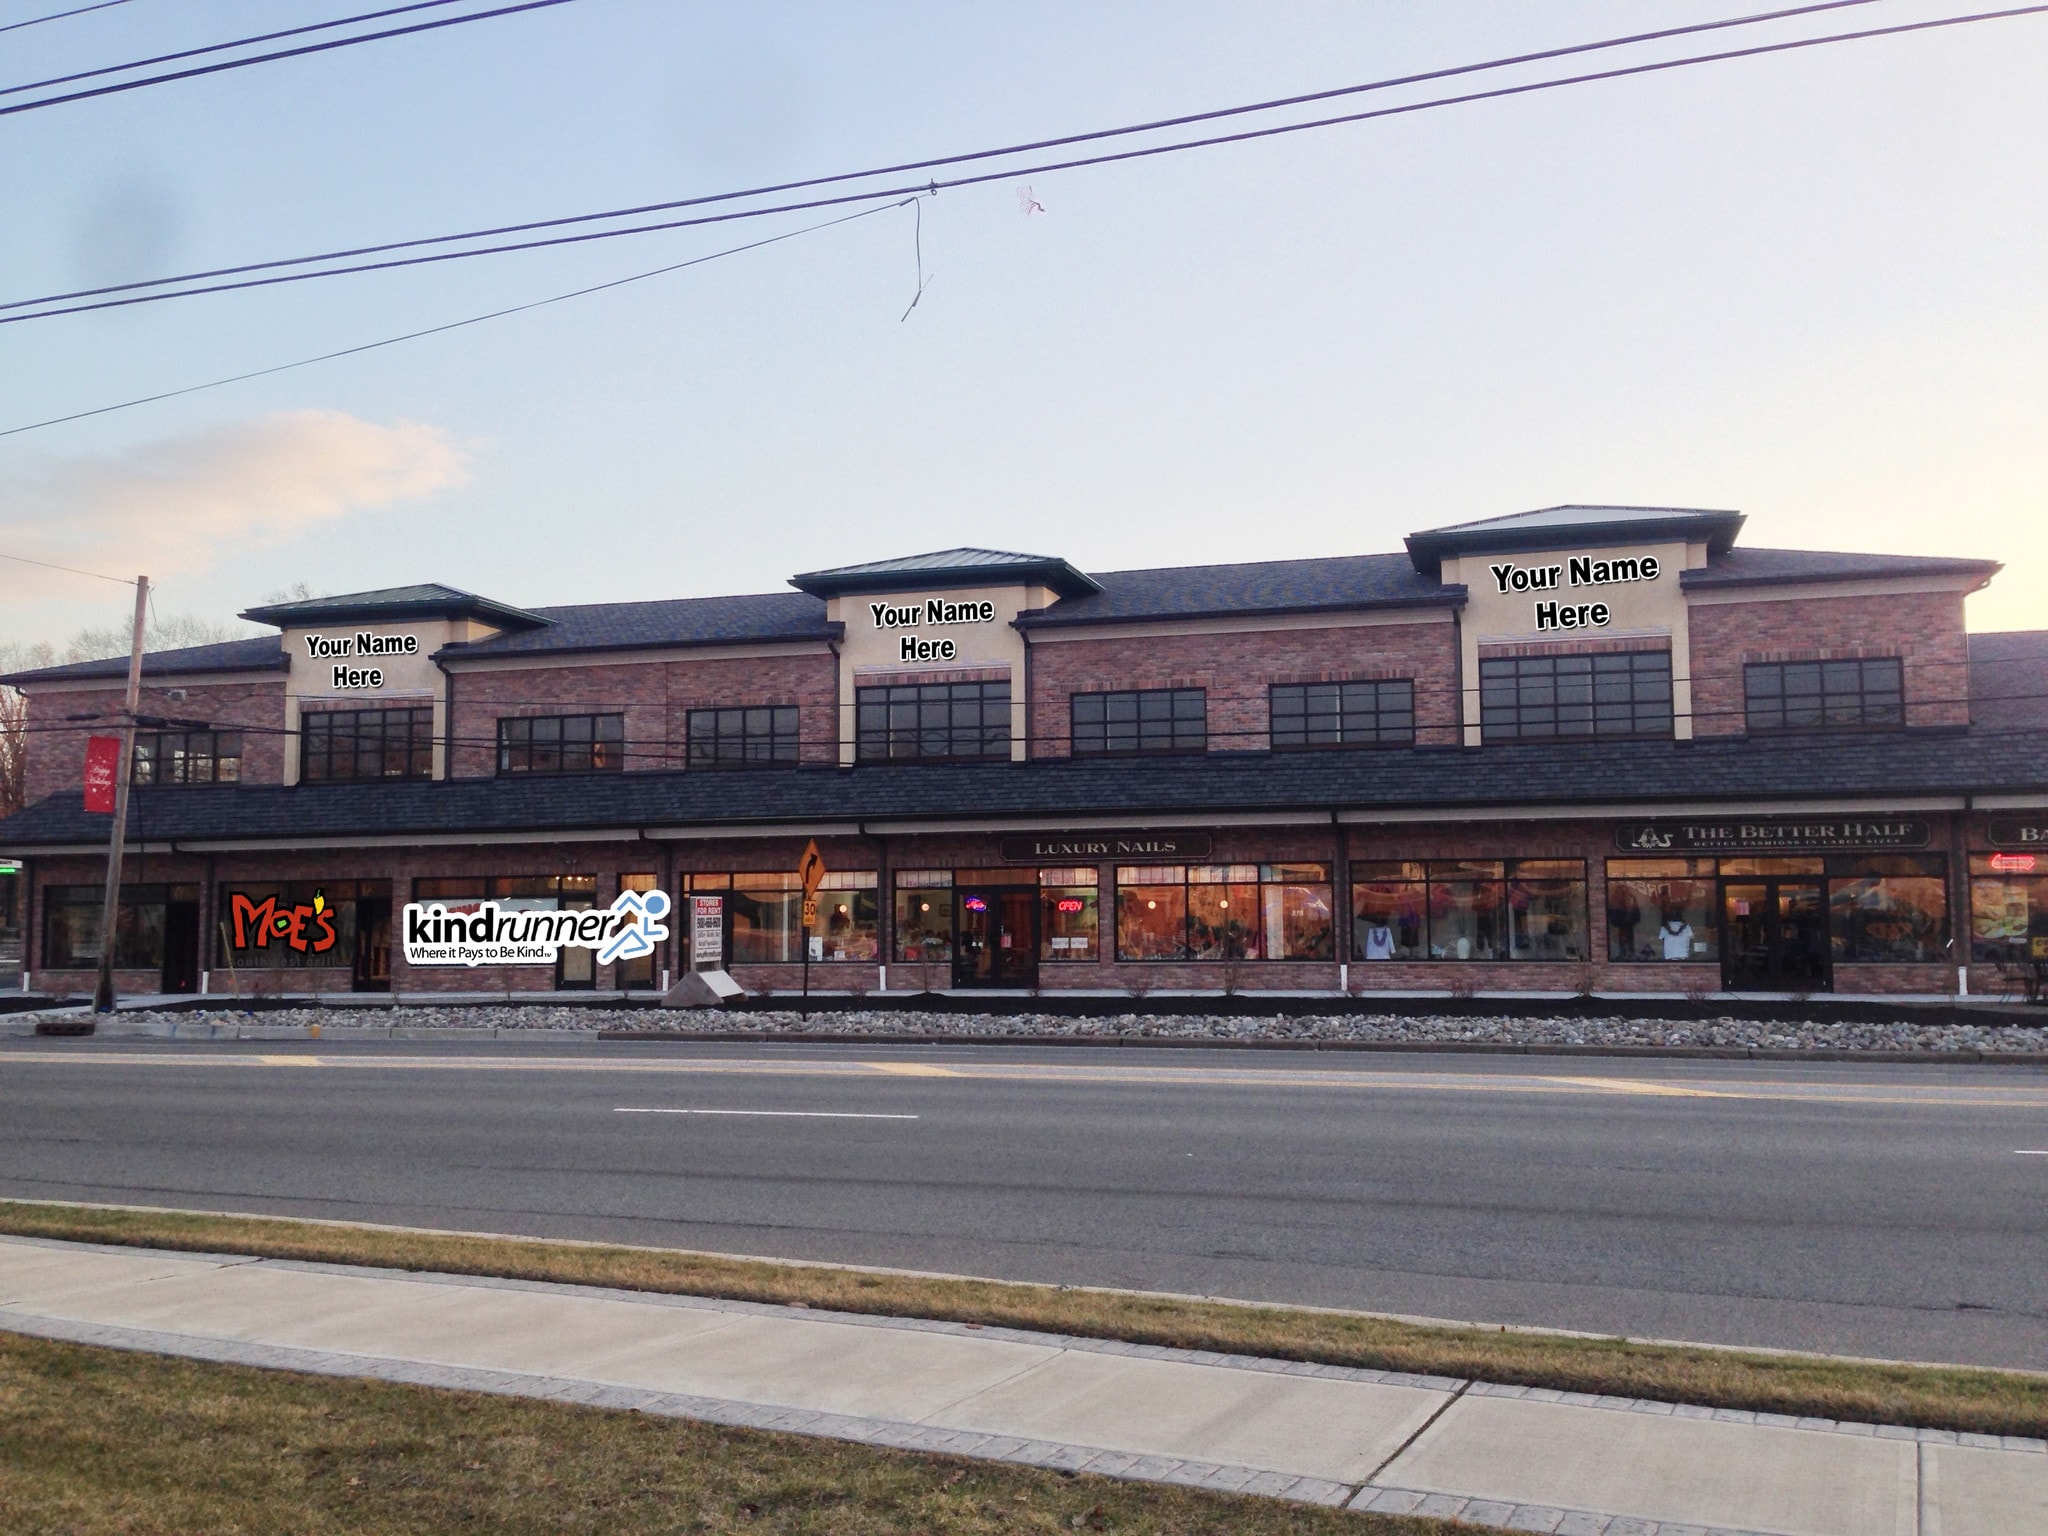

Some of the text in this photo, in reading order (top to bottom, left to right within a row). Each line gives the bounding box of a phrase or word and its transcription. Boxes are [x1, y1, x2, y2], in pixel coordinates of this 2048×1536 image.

[1682, 823, 1913, 839] THE BETTER HALF
[1035, 841, 1176, 855] LUXURY NAILS
[699, 899, 719, 907] STORES
[804, 902, 816, 916] 30
[1058, 901, 1083, 911] OPEN
[697, 907, 721, 915] FOR RENT
